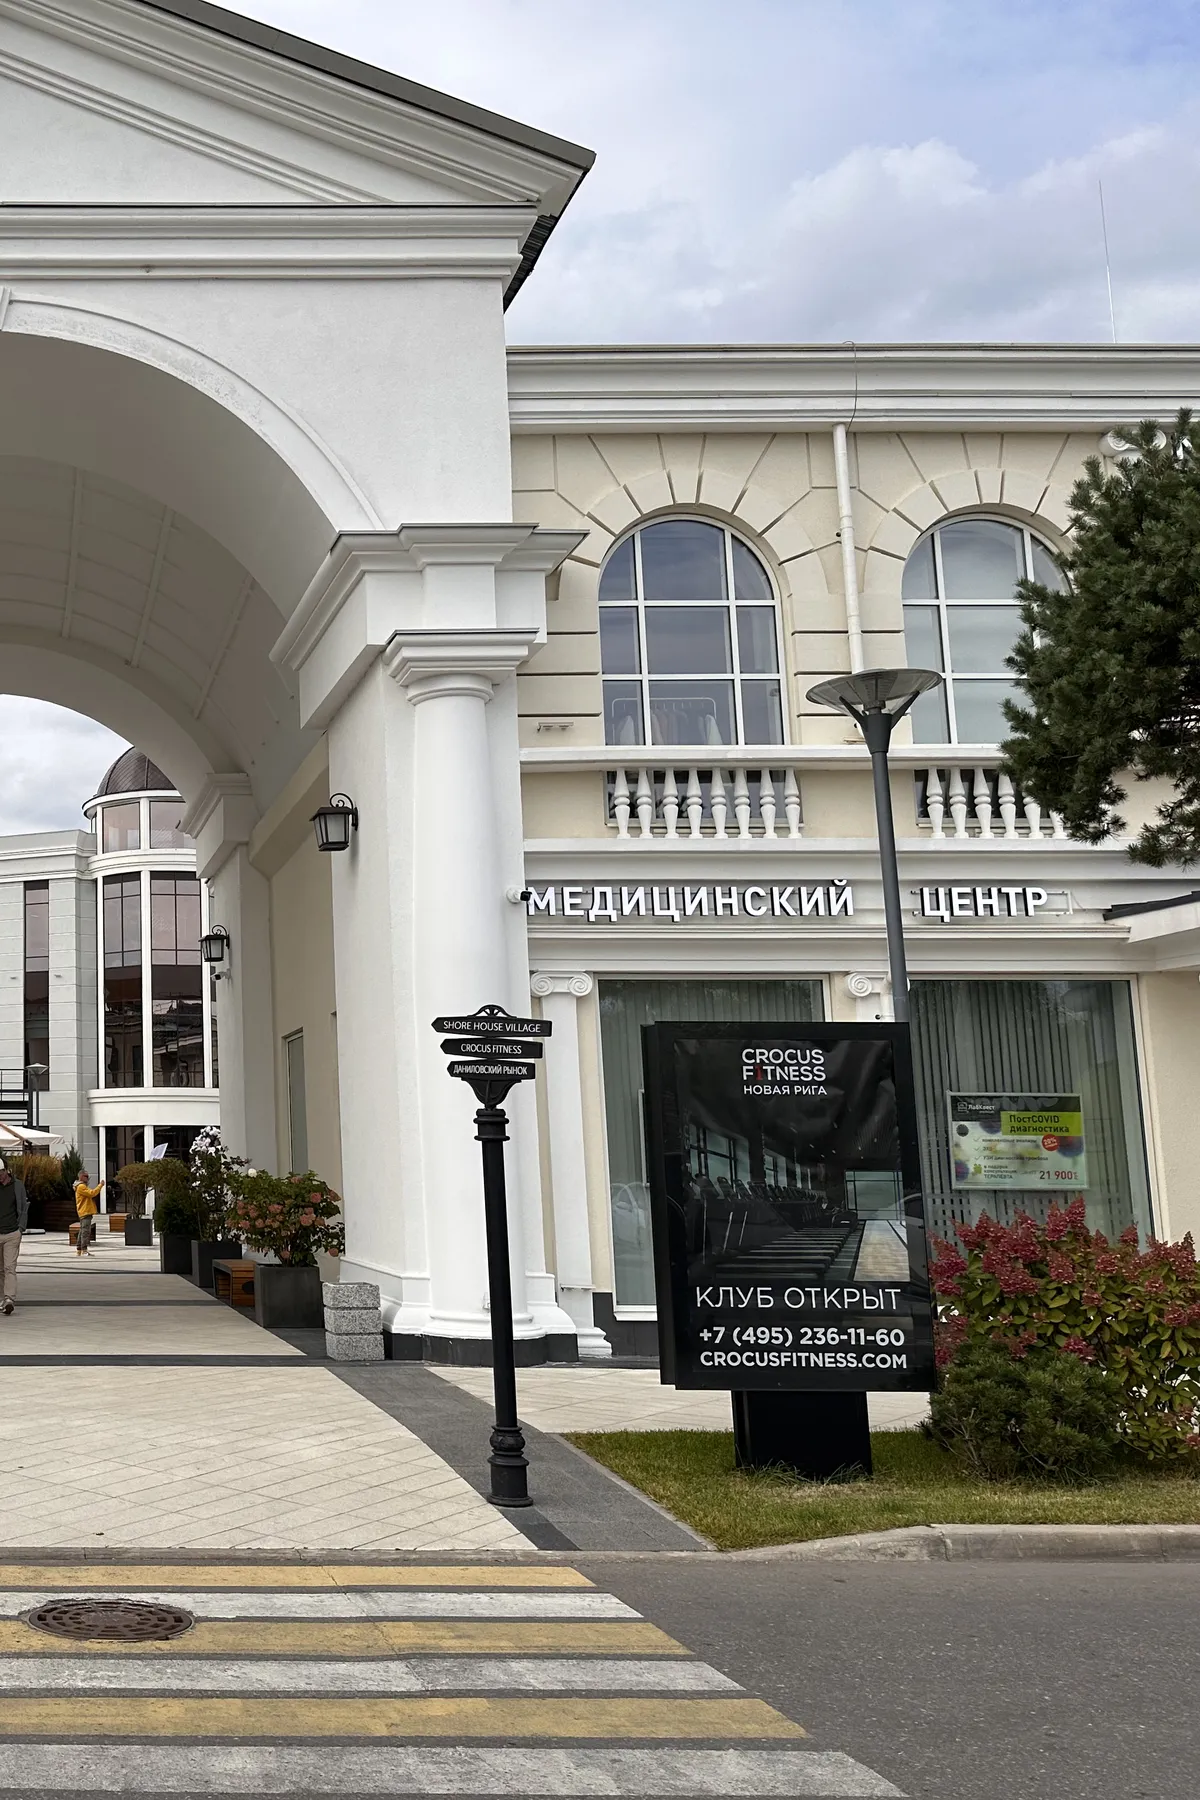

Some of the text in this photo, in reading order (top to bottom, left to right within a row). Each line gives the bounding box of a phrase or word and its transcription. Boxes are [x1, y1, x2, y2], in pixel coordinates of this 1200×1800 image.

[528, 879, 1048, 923] МЕДИЦИНСКИЙ ЦЕНТР
[443, 1020, 541, 1033] SHORE HOUSE VILLAGE
[460, 1043, 522, 1054] CROCUS FITNESS
[742, 1048, 825, 1064] CROCUS
[453, 1064, 528, 1075] ДАНИЛОВСКИЙ РЫНОК
[743, 1085, 828, 1095] НОВАЯ РИГА
[1009, 1115, 1060, 1123] ПостCOVID
[1009, 1125, 1070, 1133] диагностика
[1040, 1170, 1051, 1180] 21
[1054, 1170, 1073, 1180] 900
[696, 1286, 901, 1310] КЛУБ ОТКРЫТ
[699, 1326, 905, 1348] +7 (495) 236-11-60
[700, 1351, 907, 1369] CROCUSFITNESS.COM
